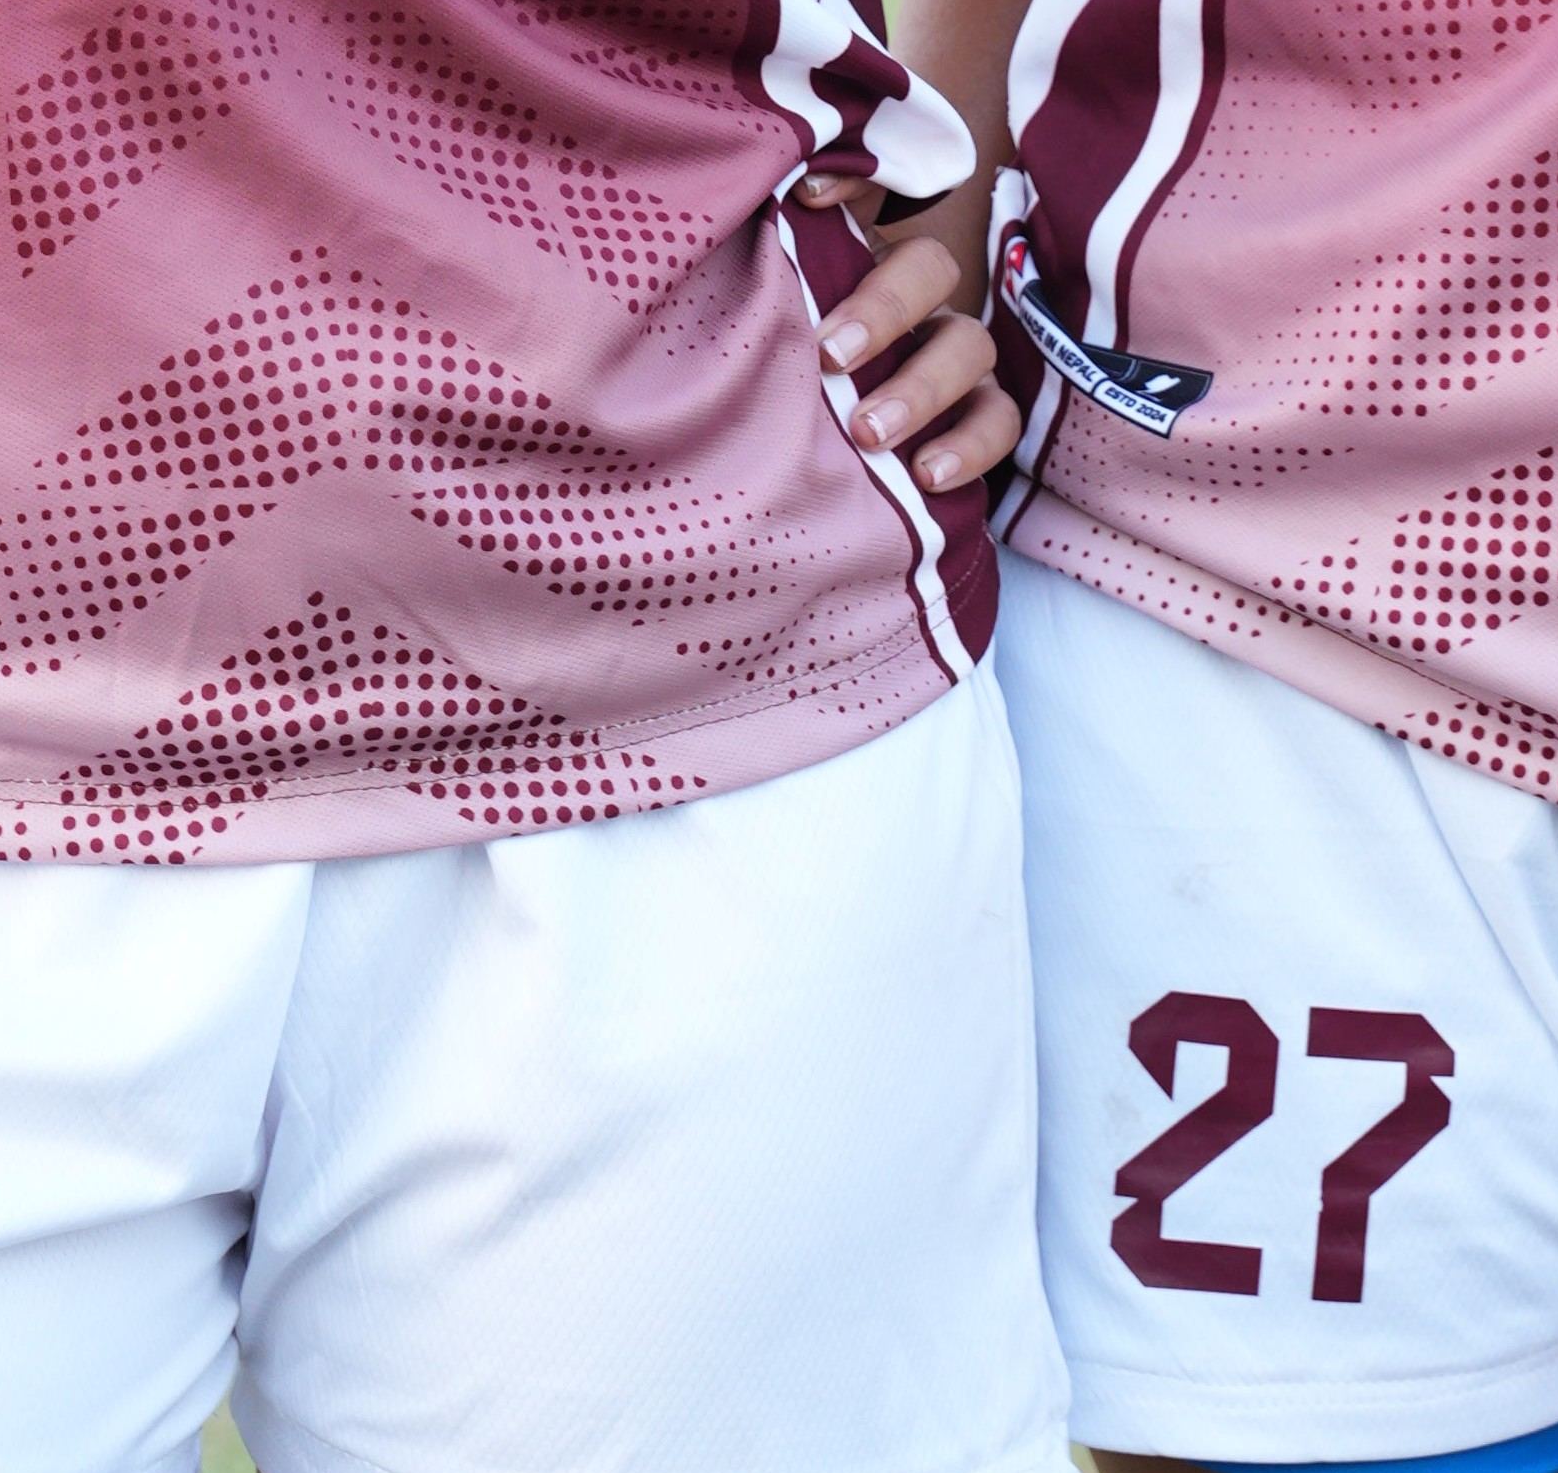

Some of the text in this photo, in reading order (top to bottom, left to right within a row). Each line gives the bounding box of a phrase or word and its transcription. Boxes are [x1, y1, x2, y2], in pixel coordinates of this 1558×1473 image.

[1056, 344, 1097, 383] NEPAL
[1105, 387, 1137, 408] ESTD
[1110, 991, 1455, 1303] 27
